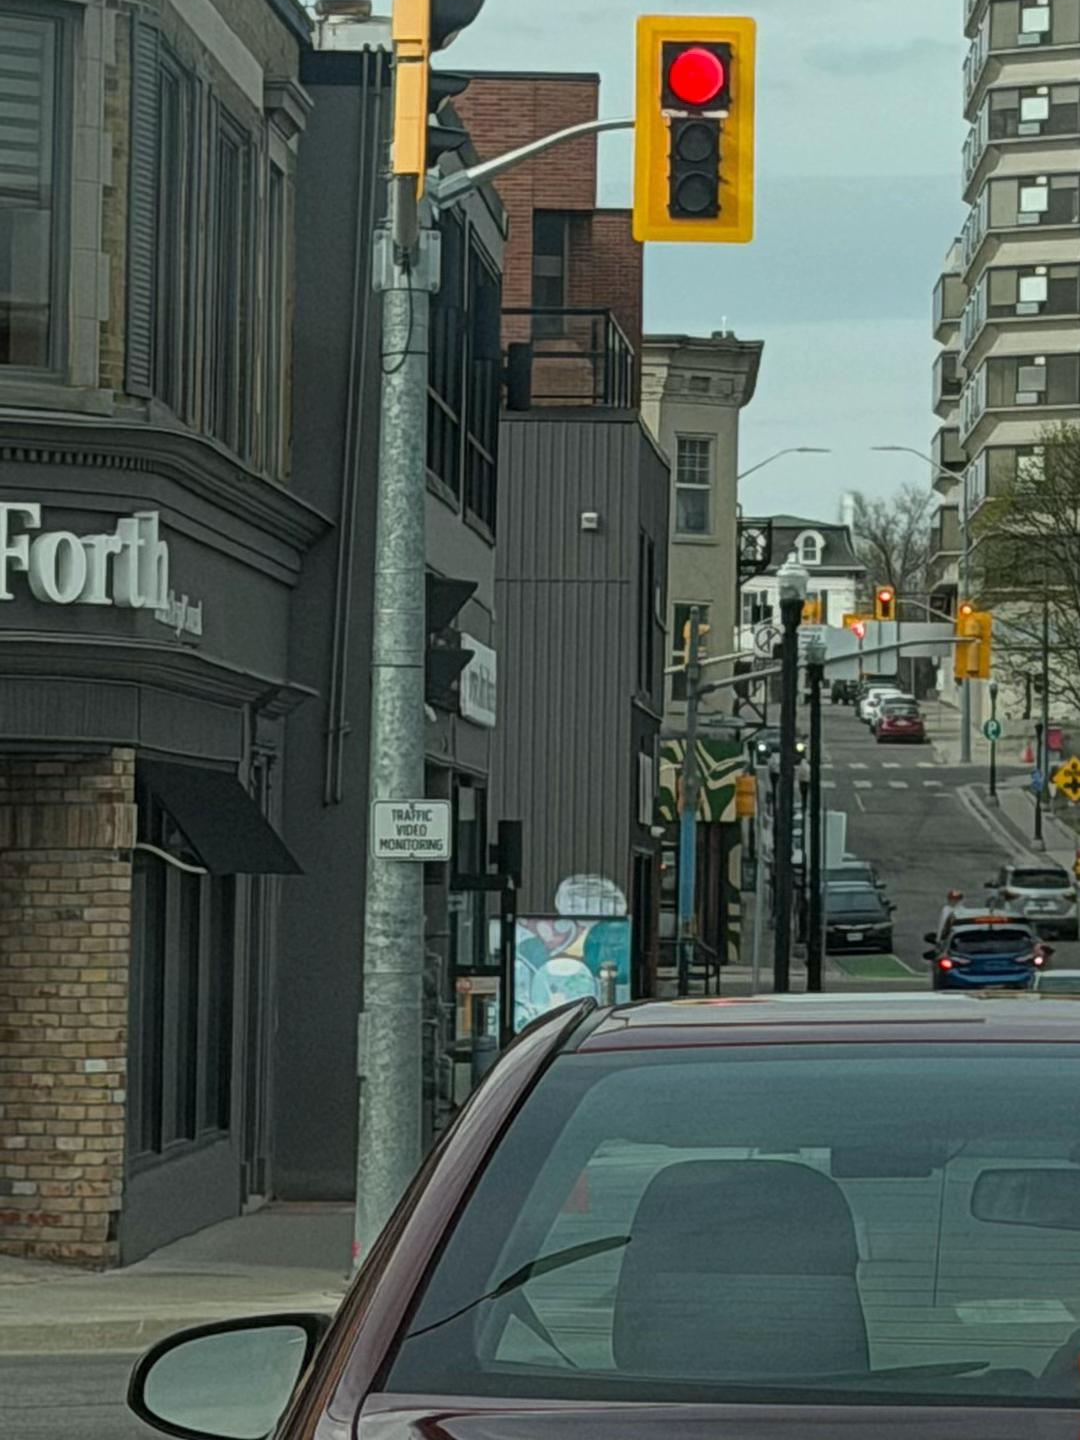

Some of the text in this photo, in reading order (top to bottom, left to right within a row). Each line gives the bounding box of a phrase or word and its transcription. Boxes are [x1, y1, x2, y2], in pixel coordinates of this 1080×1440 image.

[0, 502, 170, 609] Forth
[391, 809, 432, 822] TRAFFIC
[396, 823, 427, 837] VIDEO
[380, 838, 443, 851] MONITORING
